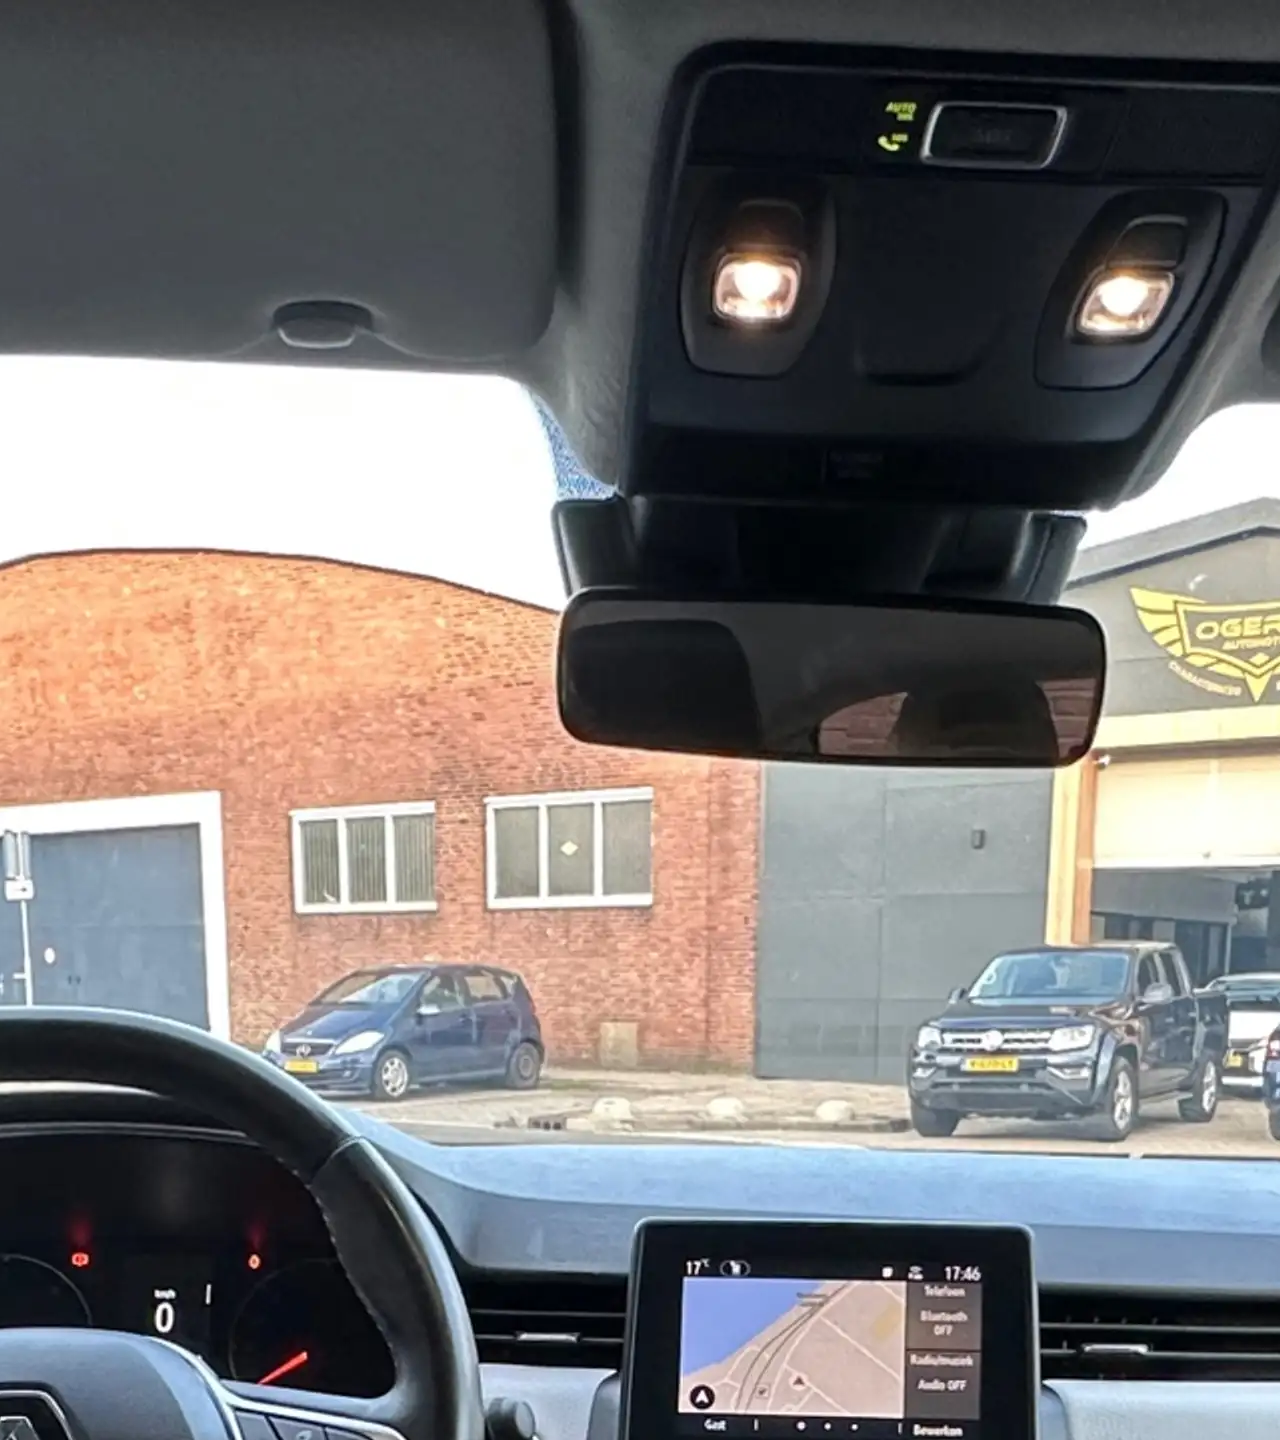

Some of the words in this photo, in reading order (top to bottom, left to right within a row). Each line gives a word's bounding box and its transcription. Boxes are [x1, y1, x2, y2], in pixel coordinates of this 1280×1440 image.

[944, 1265, 982, 1281] 17:46
[155, 1301, 174, 1333] 0
[917, 1379, 945, 1391] Audio
[947, 1380, 967, 1392] OFF
